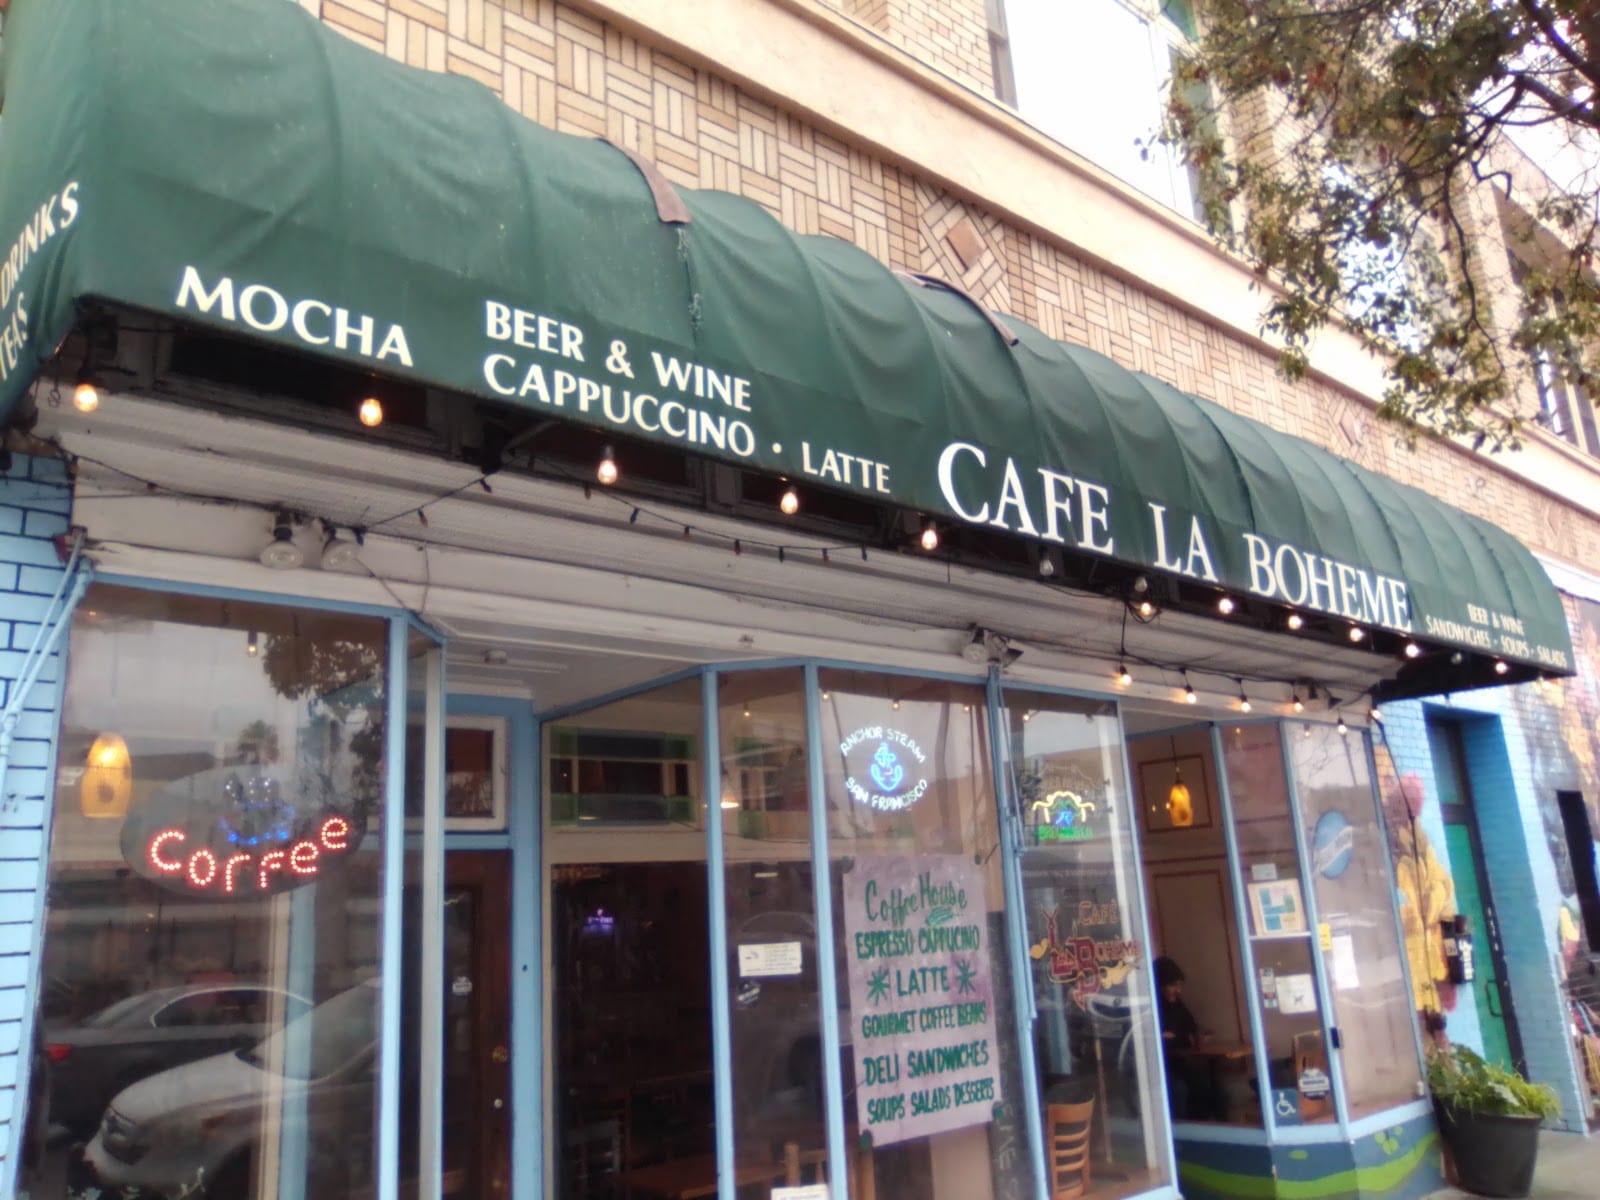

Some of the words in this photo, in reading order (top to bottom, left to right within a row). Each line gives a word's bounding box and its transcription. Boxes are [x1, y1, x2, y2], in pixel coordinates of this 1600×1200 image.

[1, 181, 79, 309] DRINKS
[175, 265, 414, 368] MOCHA
[485, 300, 585, 362] BEER
[605, 339, 635, 379] &
[650, 351, 752, 412] WINE
[483, 353, 755, 457] CAPPUCCINO
[802, 441, 891, 494] LATTE
[937, 441, 1114, 556] CAFE
[1148, 501, 1219, 583] LA
[1243, 532, 1413, 634] BOHEME
[1426, 613, 1492, 649] SANDWICHES
[1501, 634, 1530, 659] SOUPS
[1467, 602, 1489, 626] BEER
[1500, 613, 1525, 636] WINE
[840, 726, 883, 757] ANCHOR
[886, 728, 926, 764] STEAM
[846, 776, 870, 804] SAN
[871, 778, 928, 812] FRANCISCO
[855, 928, 914, 959] ESPRESSO
[896, 965, 950, 997] LATTE
[862, 1010, 917, 1039] GOURMET
[919, 1004, 955, 1033] COFFEE
[863, 1053, 900, 1087] DELI
[907, 1039, 990, 1079] SANDWICHES
[867, 1093, 906, 1125] SOUPS
[911, 1086, 951, 1117] SALADS
